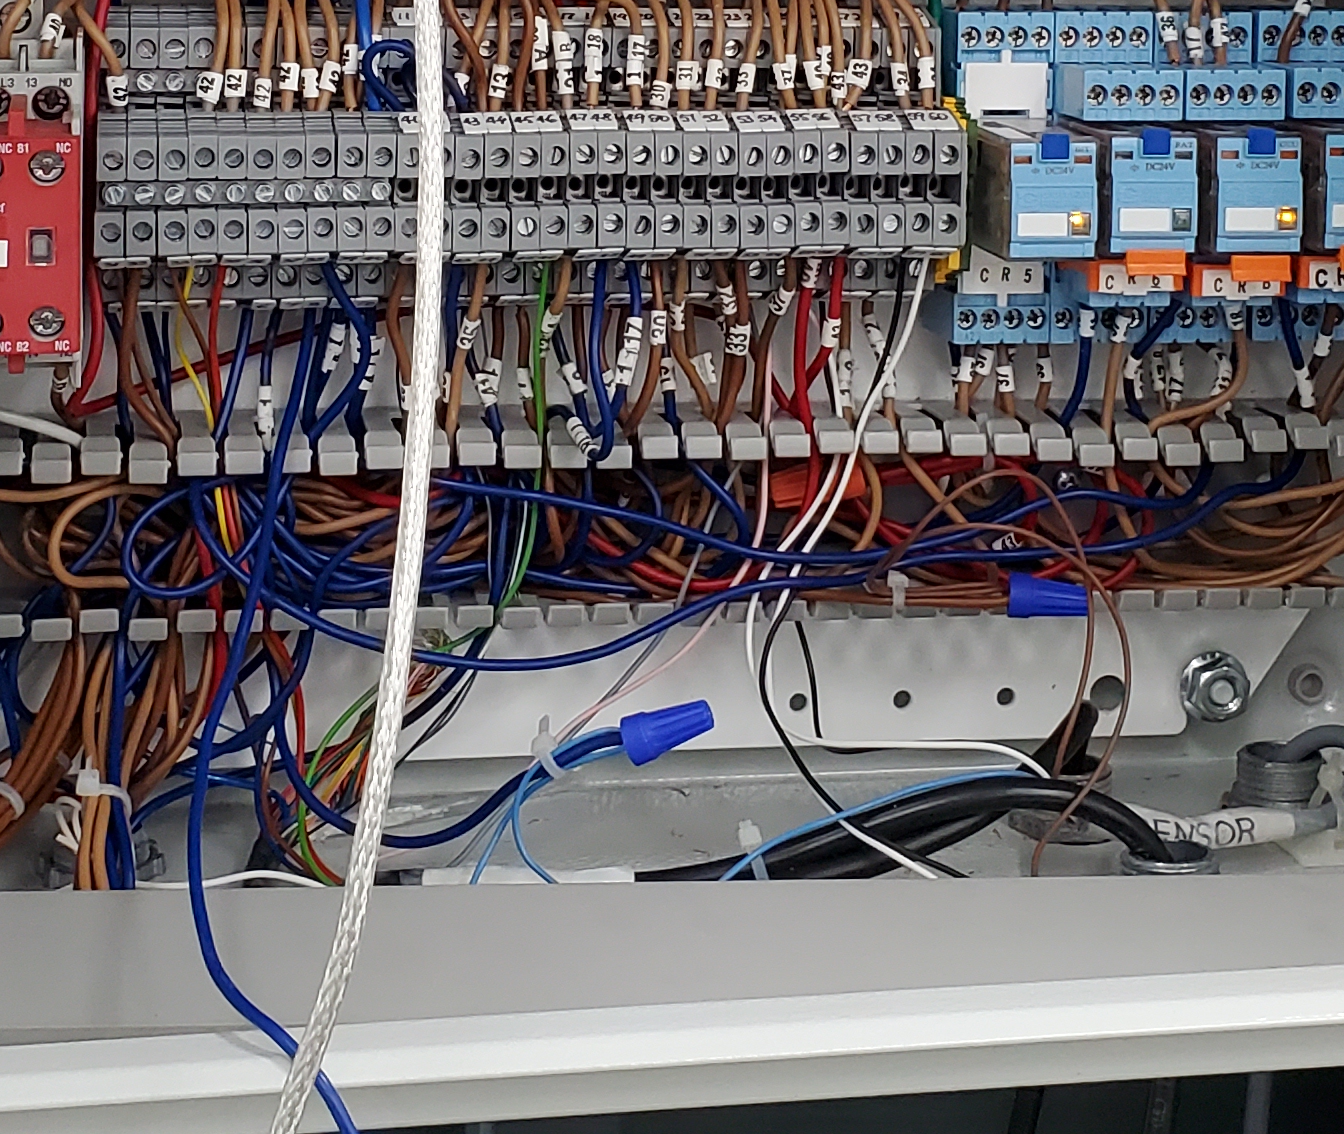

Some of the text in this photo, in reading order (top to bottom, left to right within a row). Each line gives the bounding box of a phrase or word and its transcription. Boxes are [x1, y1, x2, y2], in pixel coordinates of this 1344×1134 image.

[851, 61, 869, 79] 43
[0, 78, 15, 88] L3
[25, 77, 73, 88] 13 NO
[198, 75, 215, 94] 42
[226, 73, 243, 91] 42
[490, 72, 509, 94] 13
[113, 86, 128, 103] 42
[16, 143, 29, 154] 81
[56, 142, 72, 153] NC
[16, 341, 30, 353] 82
[55, 340, 70, 351] NC
[1154, 816, 1256, 847] ENSOR
